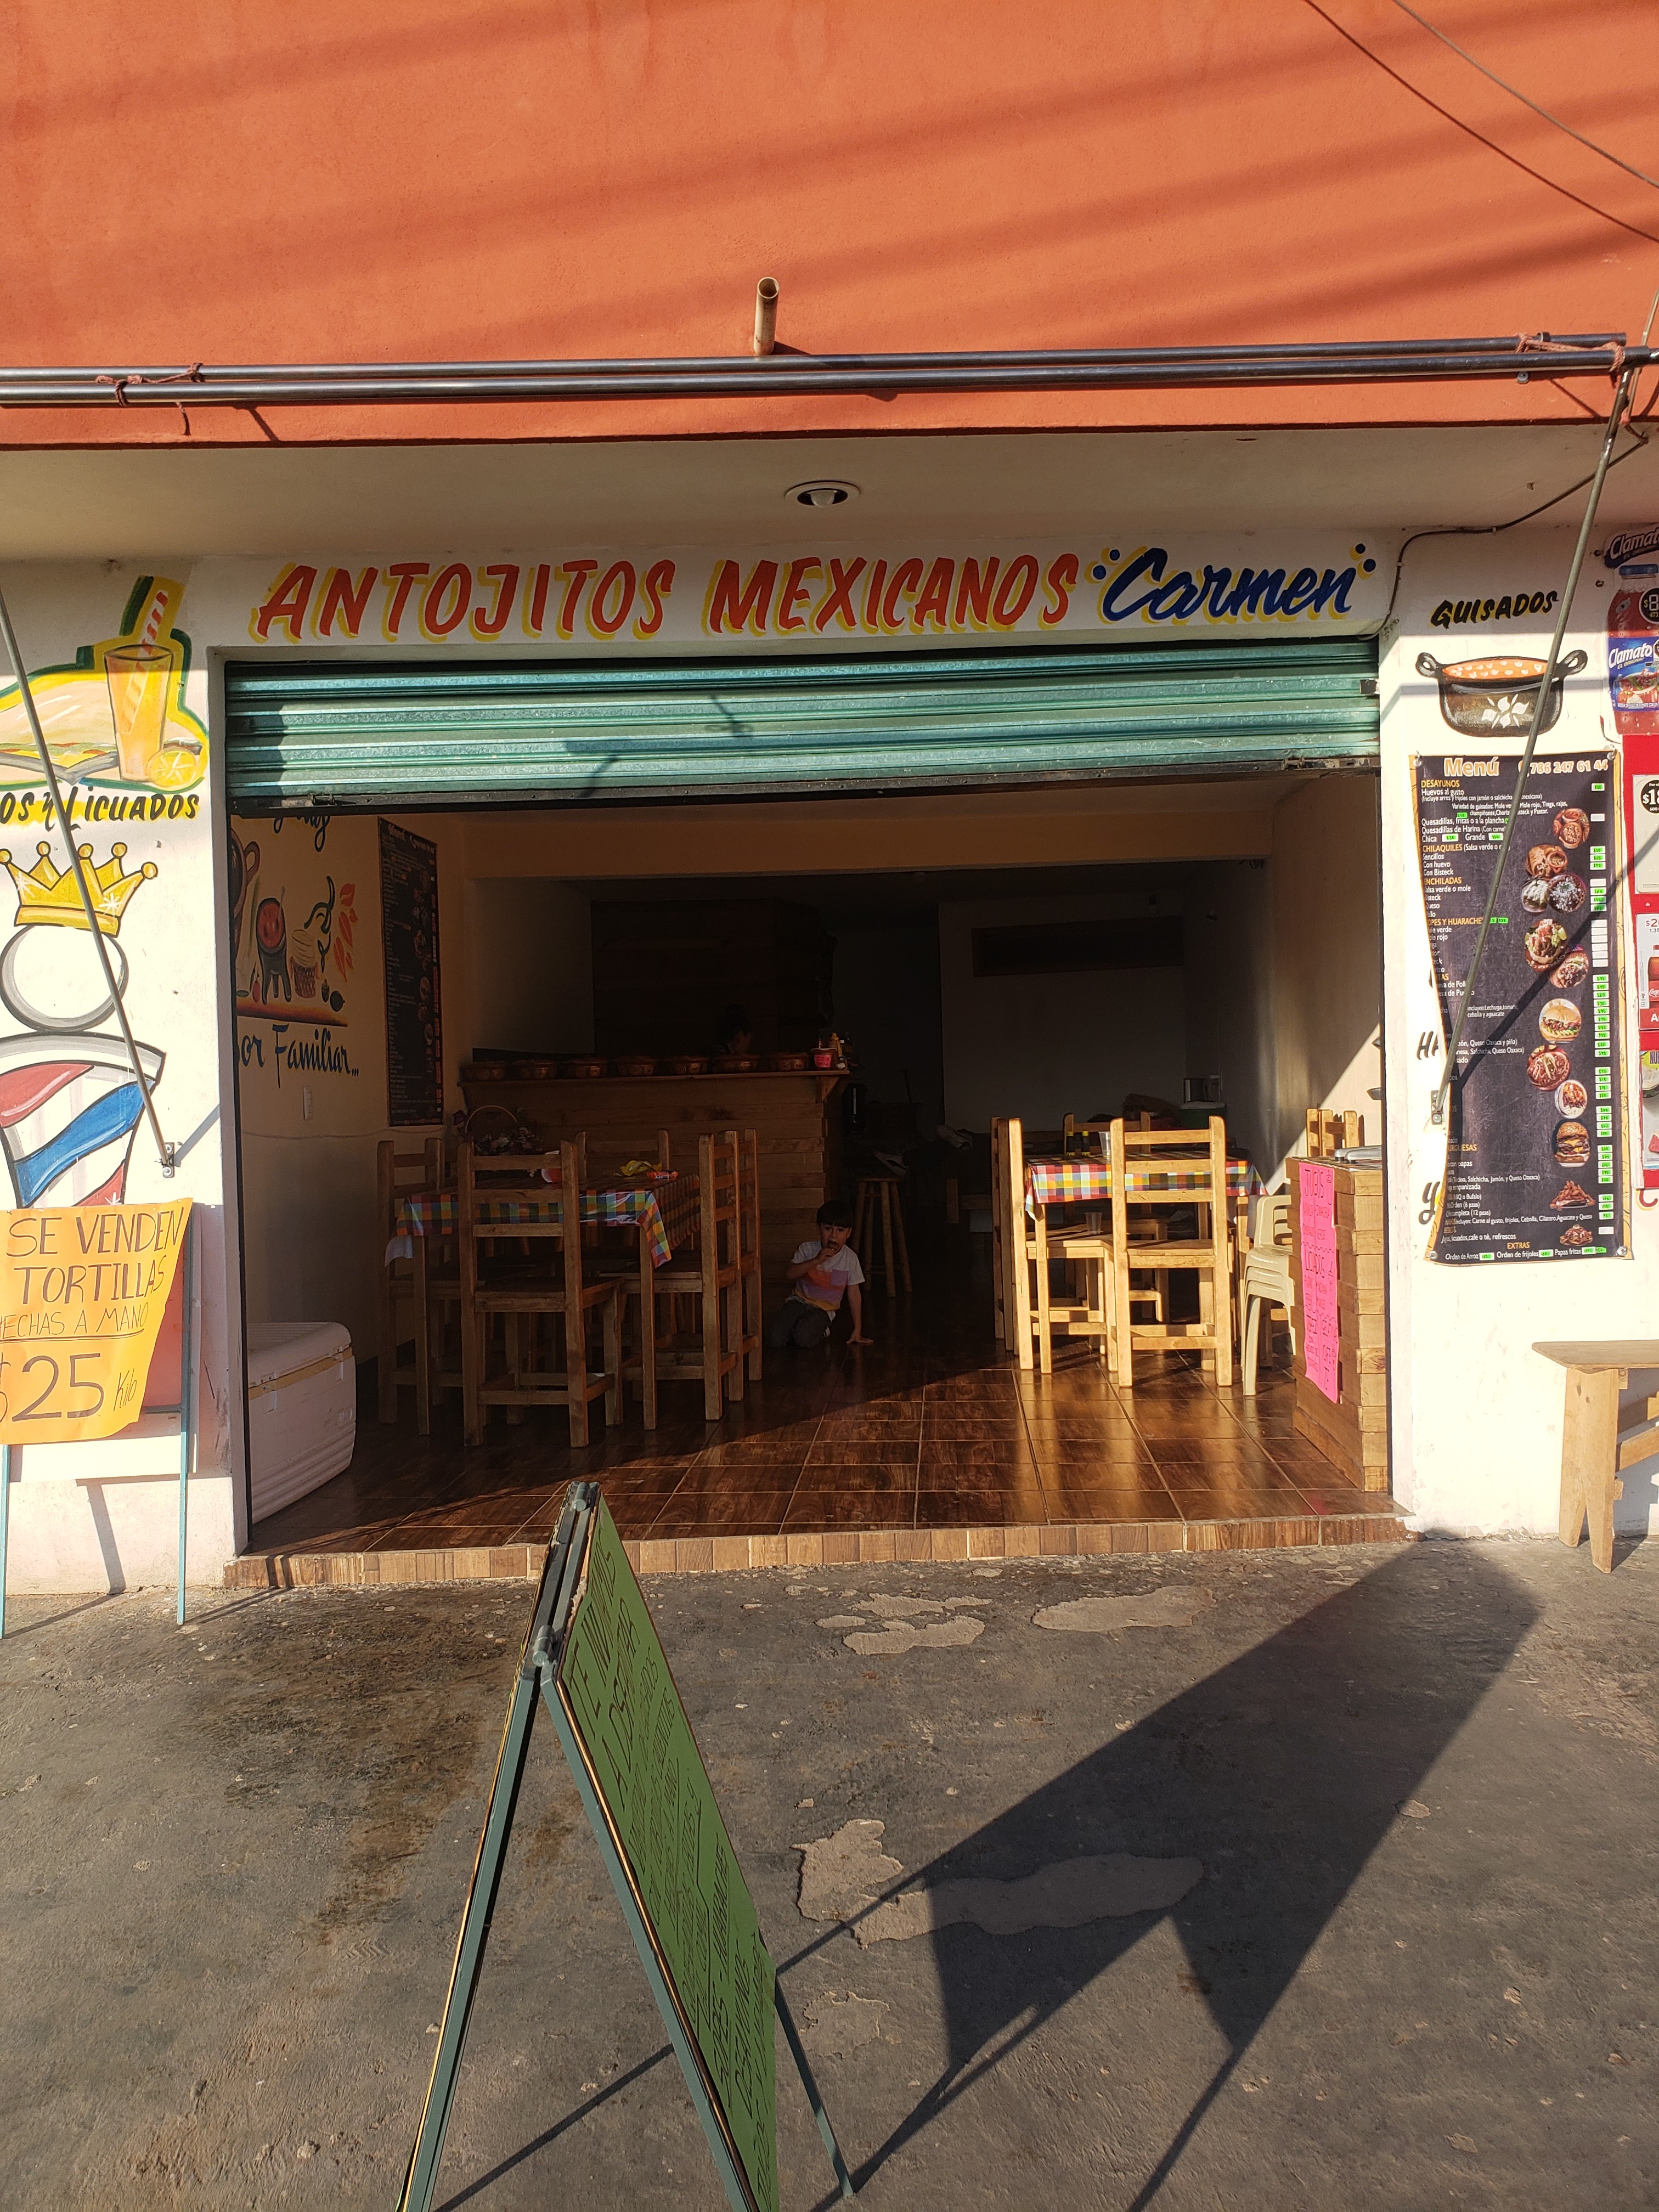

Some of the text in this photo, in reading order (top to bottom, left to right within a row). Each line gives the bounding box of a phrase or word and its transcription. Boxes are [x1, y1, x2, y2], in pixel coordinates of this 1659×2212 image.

[250, 548, 1356, 643] ANTOJITOS MEXICANOS Carmen
[1430, 591, 1559, 629] GUISADOS
[1609, 643, 1652, 669] Clamato
[1421, 780, 1460, 788] DESAYUNOS
[1443, 757, 1609, 777] Menú 786 247 61 44
[1421, 817, 1454, 826] Quesadillas,
[1485, 816, 1505, 825] plancha
[1421, 826, 1453, 834] Quesadillas
[1423, 844, 1463, 853] CHILAQUILES
[1463, 844, 1477, 852] (Salsa
[1424, 877, 1462, 885] ENCHILADAS
[1645, 918, 1659, 927] $2
[6, 1206, 184, 1257] SE VENDEN
[1522, 1250, 1539, 1259] frijoles
[13, 1254, 167, 1305] TORTILLAS
[74, 1310, 87, 1334] A
[96, 1302, 149, 1333] MANO
[112, 1368, 138, 1412] Kilo
[568, 1527, 616, 1740] TE INVITAMOS
[601, 1599, 639, 1811] A DISFRUTAR
[648, 1688, 675, 1926] CON TORTILLAS CALIENTITAS
[663, 1758, 677, 1929] HECHAS A MANO
[681, 1802, 696, 2022] QUESADILLAS FRITAS
[696, 1899, 708, 2015] AL COMAL
[712, 1833, 730, 2107] SOPES HUARACHES
[734, 1942, 752, 2114] DESAYUNOS
